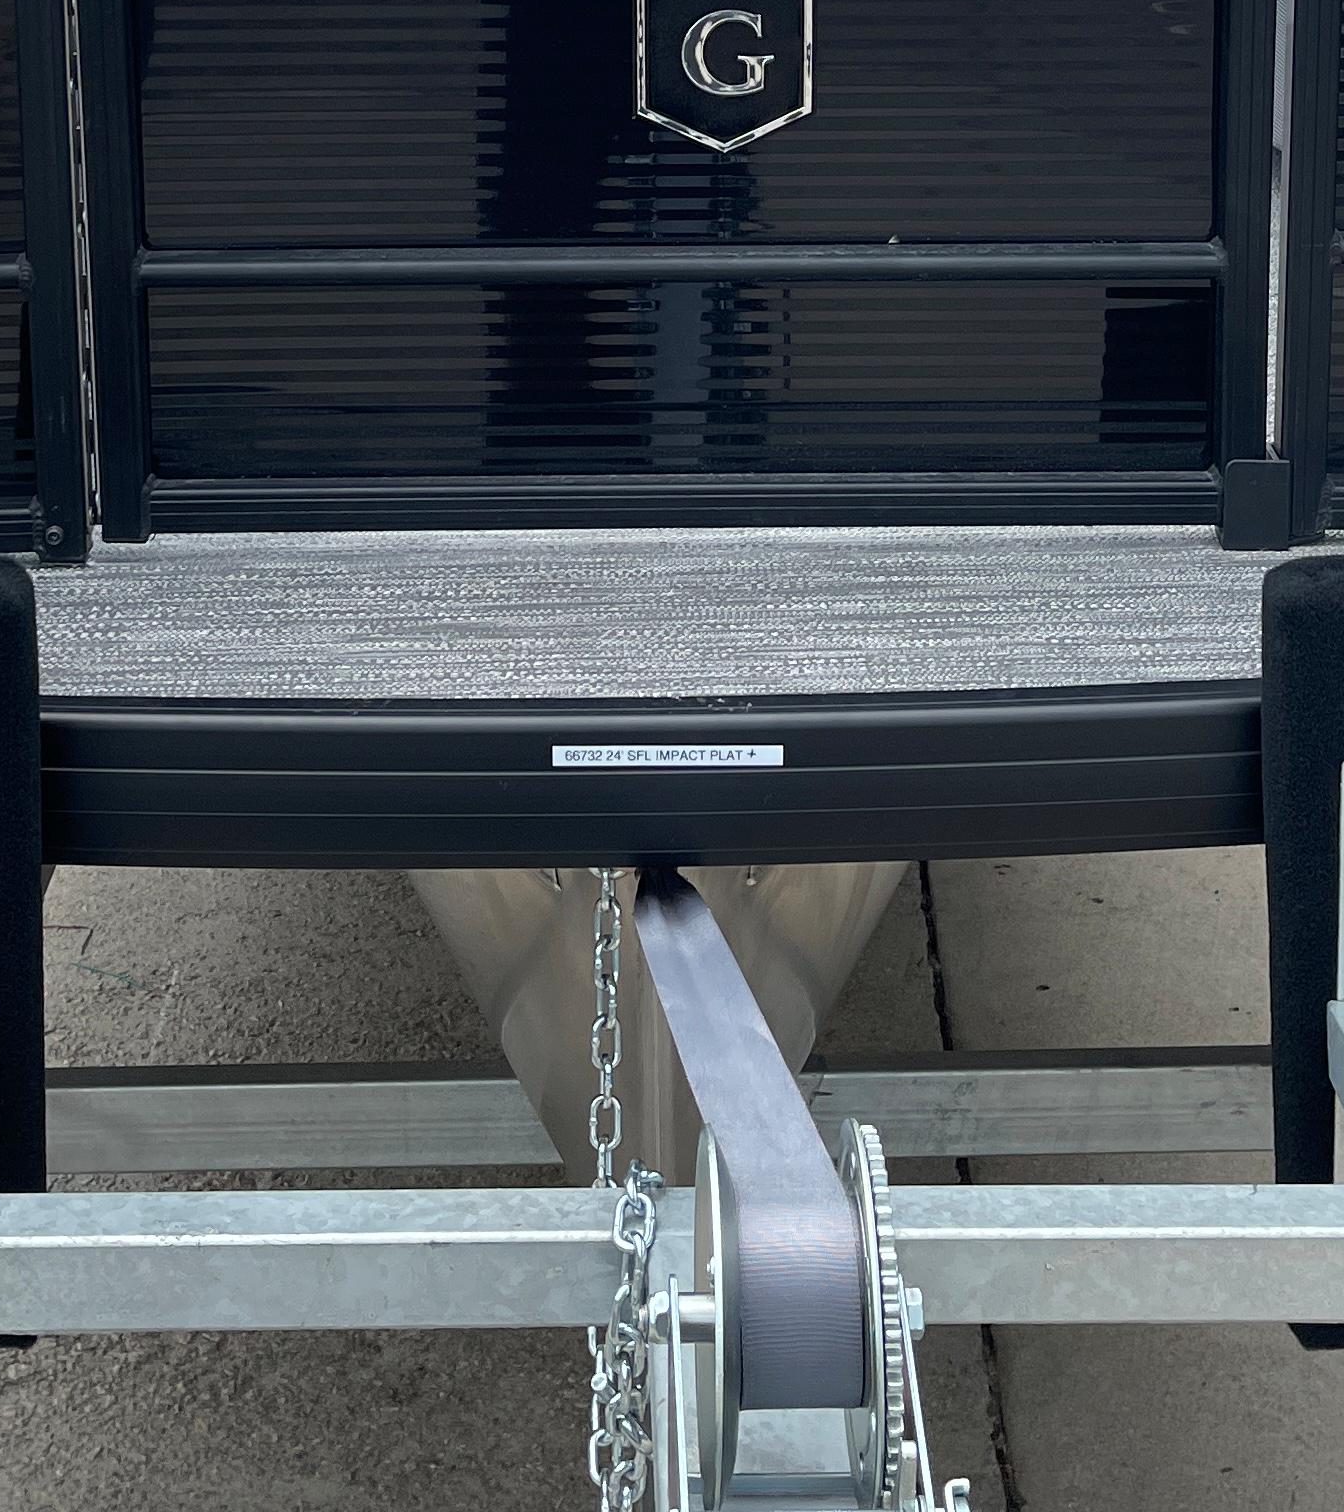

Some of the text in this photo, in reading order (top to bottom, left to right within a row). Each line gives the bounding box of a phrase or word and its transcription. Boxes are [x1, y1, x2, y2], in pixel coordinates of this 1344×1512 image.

[681, 9, 775, 96] G
[564, 750, 603, 761] 66732
[627, 750, 651, 761] SFL
[656, 750, 706, 761] IMPACT
[710, 750, 743, 761] PLAT
